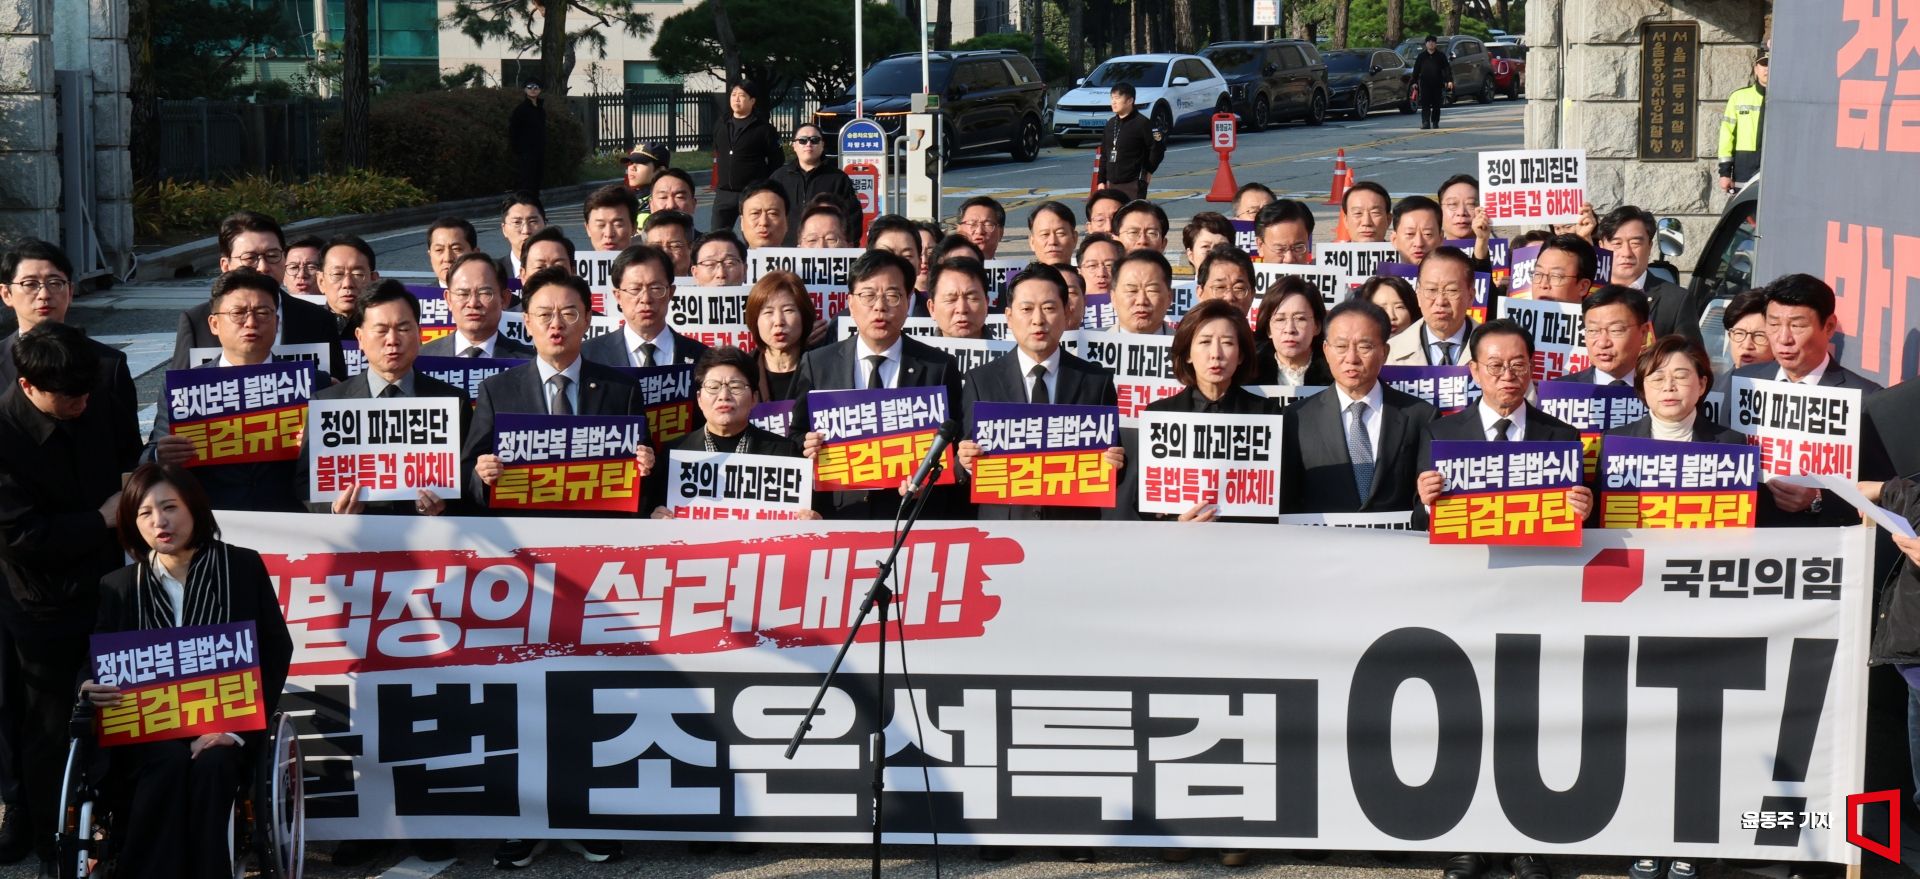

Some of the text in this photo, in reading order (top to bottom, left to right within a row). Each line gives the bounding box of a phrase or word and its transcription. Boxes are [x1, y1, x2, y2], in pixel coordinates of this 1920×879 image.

[1650, 31, 1667, 153] 서울중앙지방검찰청
[1672, 31, 1687, 153] 서울고등검찰청
[851, 178, 873, 191] 행금지
[1487, 157, 1578, 186] 정의 파괴집단
[1485, 188, 1583, 218] 불법특검 해체!
[801, 256, 857, 286] 파괴집
[670, 294, 703, 325] 정의
[170, 367, 312, 420] 정치보복 불법수사
[1738, 388, 1849, 437] 정의 파괴집단
[174, 406, 309, 461] 특검규탄
[321, 408, 449, 448] 정의 파괴집단
[812, 392, 945, 442] 정치보복 불법수사
[976, 413, 1114, 452] 정치보복 불법수사
[498, 428, 567, 463] 정치보복
[571, 423, 640, 459] 불법수사
[1150, 423, 1271, 462] 정의 파괴집단
[1799, 439, 1853, 480] 해체!
[316, 452, 455, 492] 불법특검 해체!
[495, 461, 638, 505] 특검규탄
[680, 461, 803, 504] 정의 파괴집단
[975, 453, 1112, 499] 특검규탄
[1145, 466, 1275, 506] 불법특검 해체!
[1435, 454, 1504, 492] 정치보복
[1508, 449, 1580, 488] 불법수사
[1607, 454, 1678, 489] 정치보복
[1681, 453, 1755, 488] 불법수사
[1434, 491, 1575, 540] 특검규탄
[1661, 556, 1844, 601] 국민의힘
[277, 541, 971, 665] 법정의 살려내라!
[96, 628, 254, 687] 정치보복 불법수사
[101, 671, 257, 738] 특검규탄
[588, 684, 1277, 822] 조은석특검
[1346, 626, 1840, 847] OUT!
